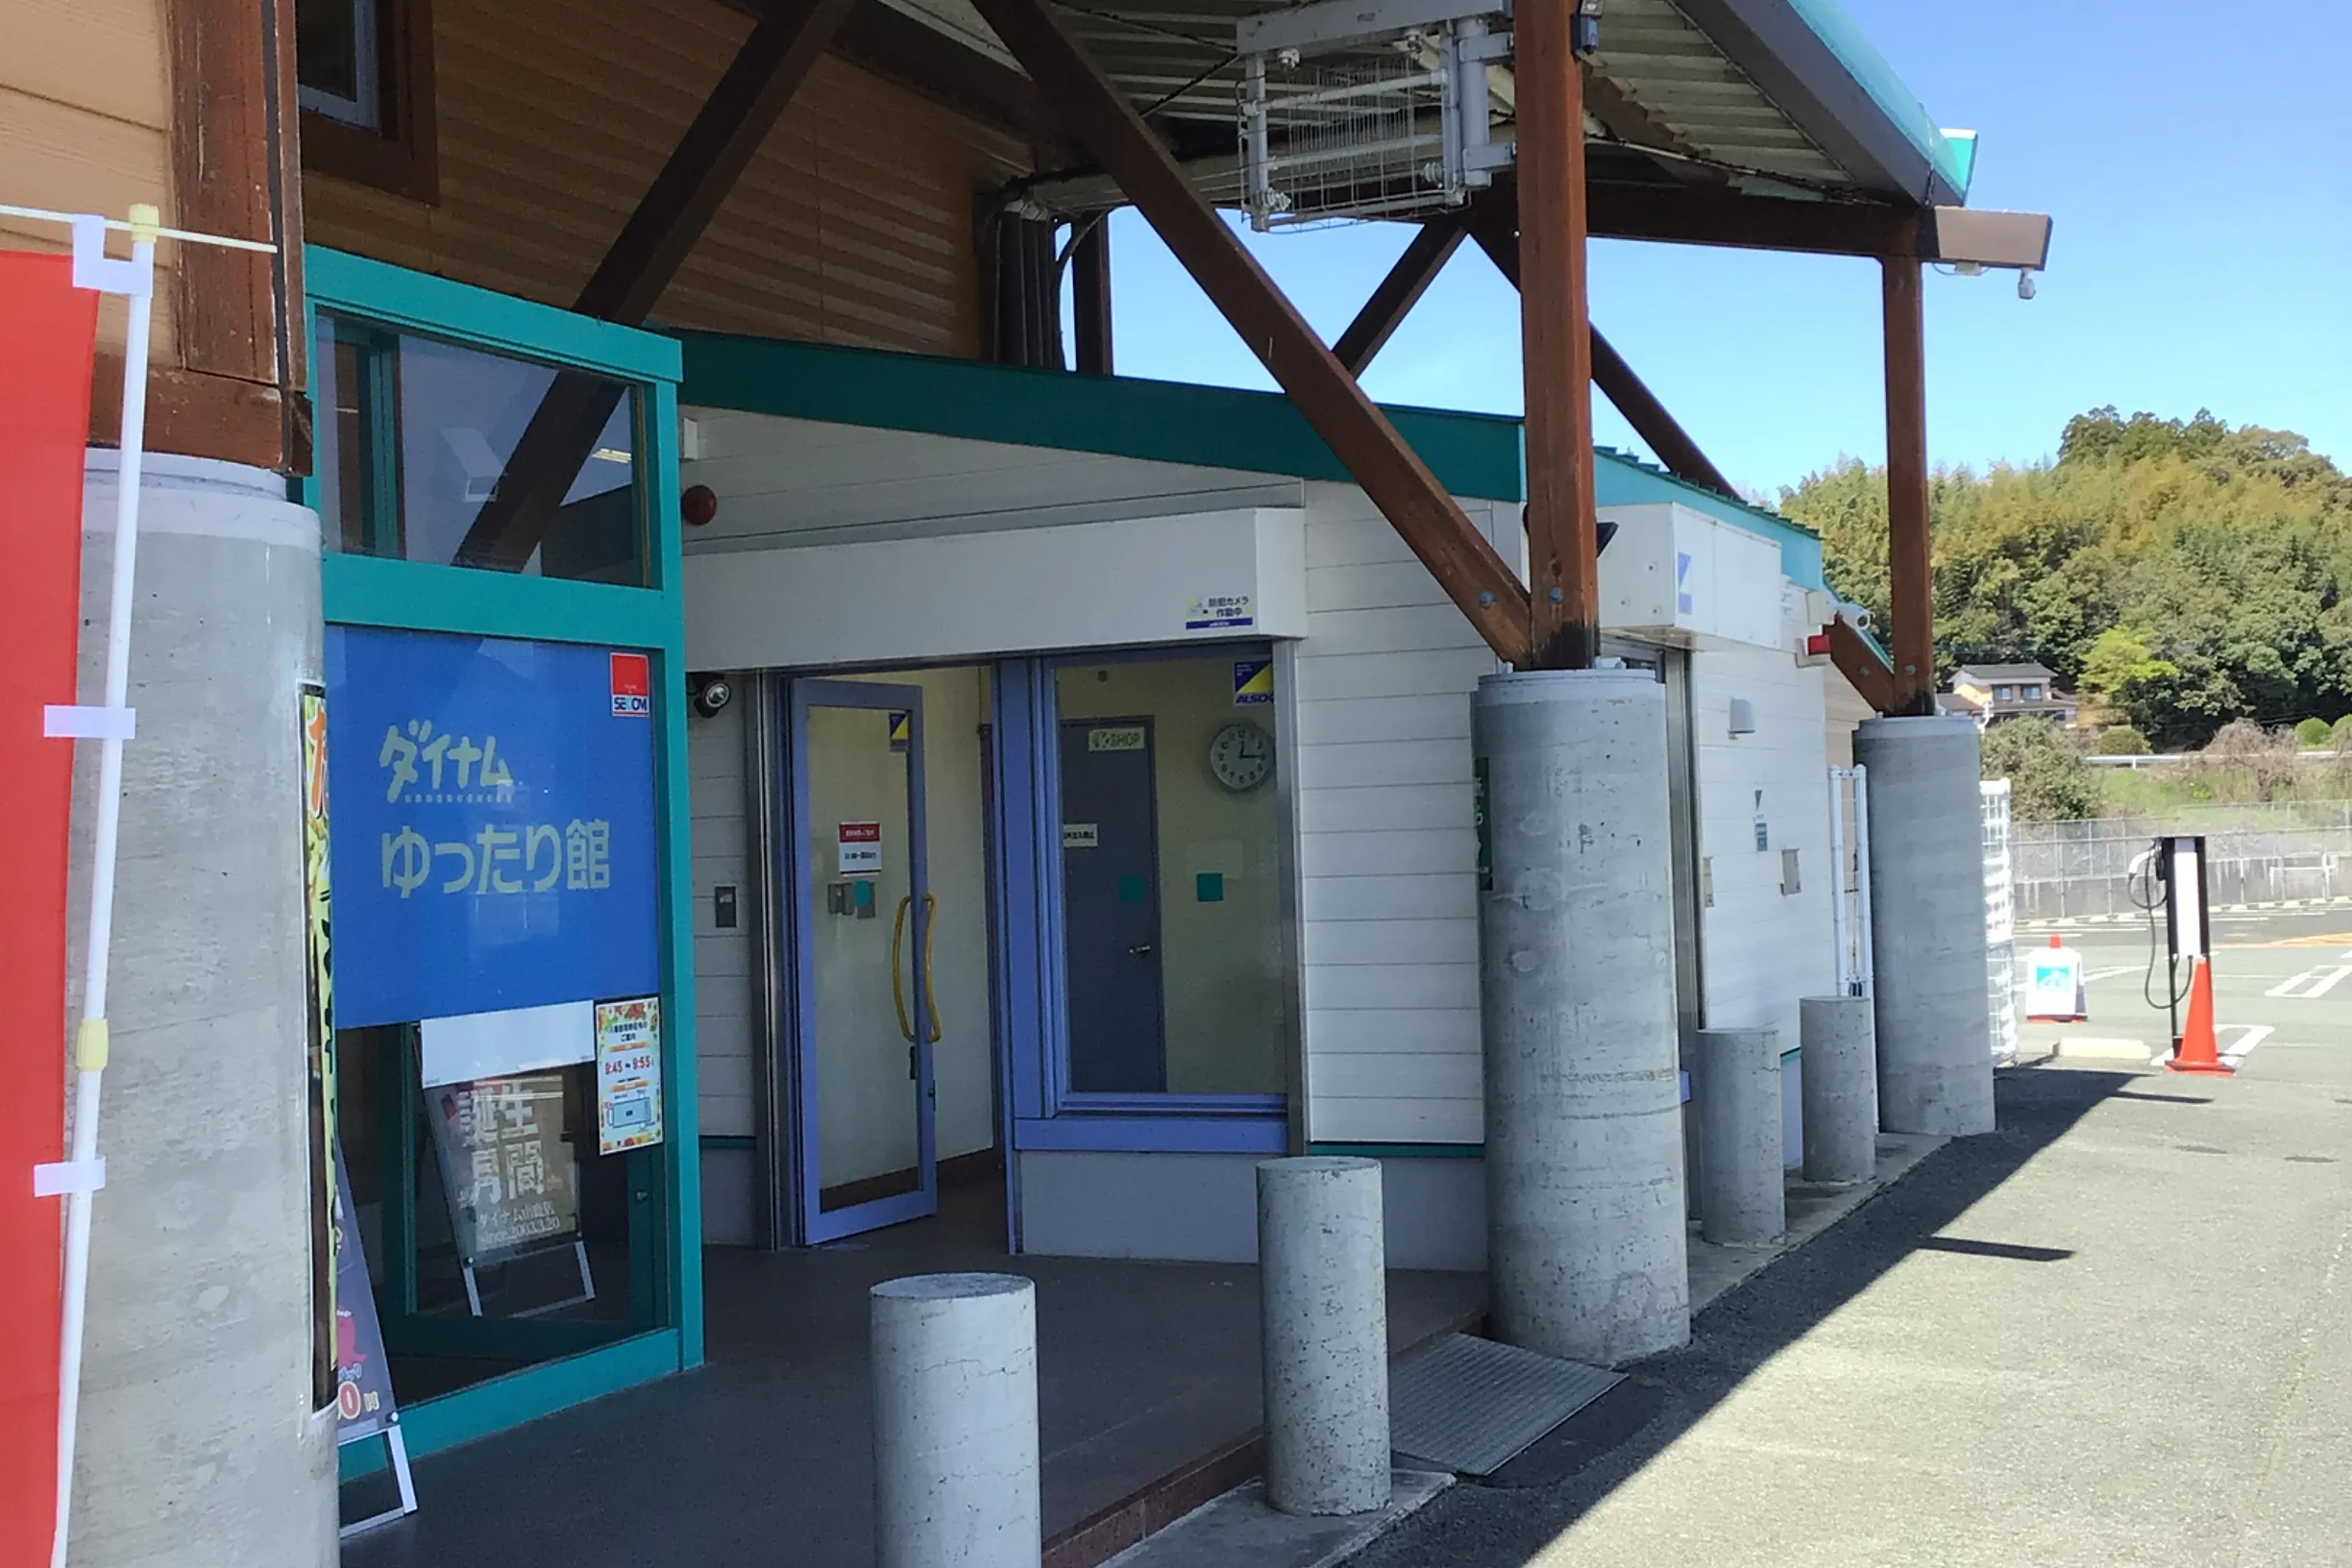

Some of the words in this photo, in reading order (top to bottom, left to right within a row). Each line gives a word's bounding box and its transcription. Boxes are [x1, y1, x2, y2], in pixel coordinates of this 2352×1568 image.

[379, 719, 512, 803] ダイナム
[381, 819, 610, 898] ゆったり館
